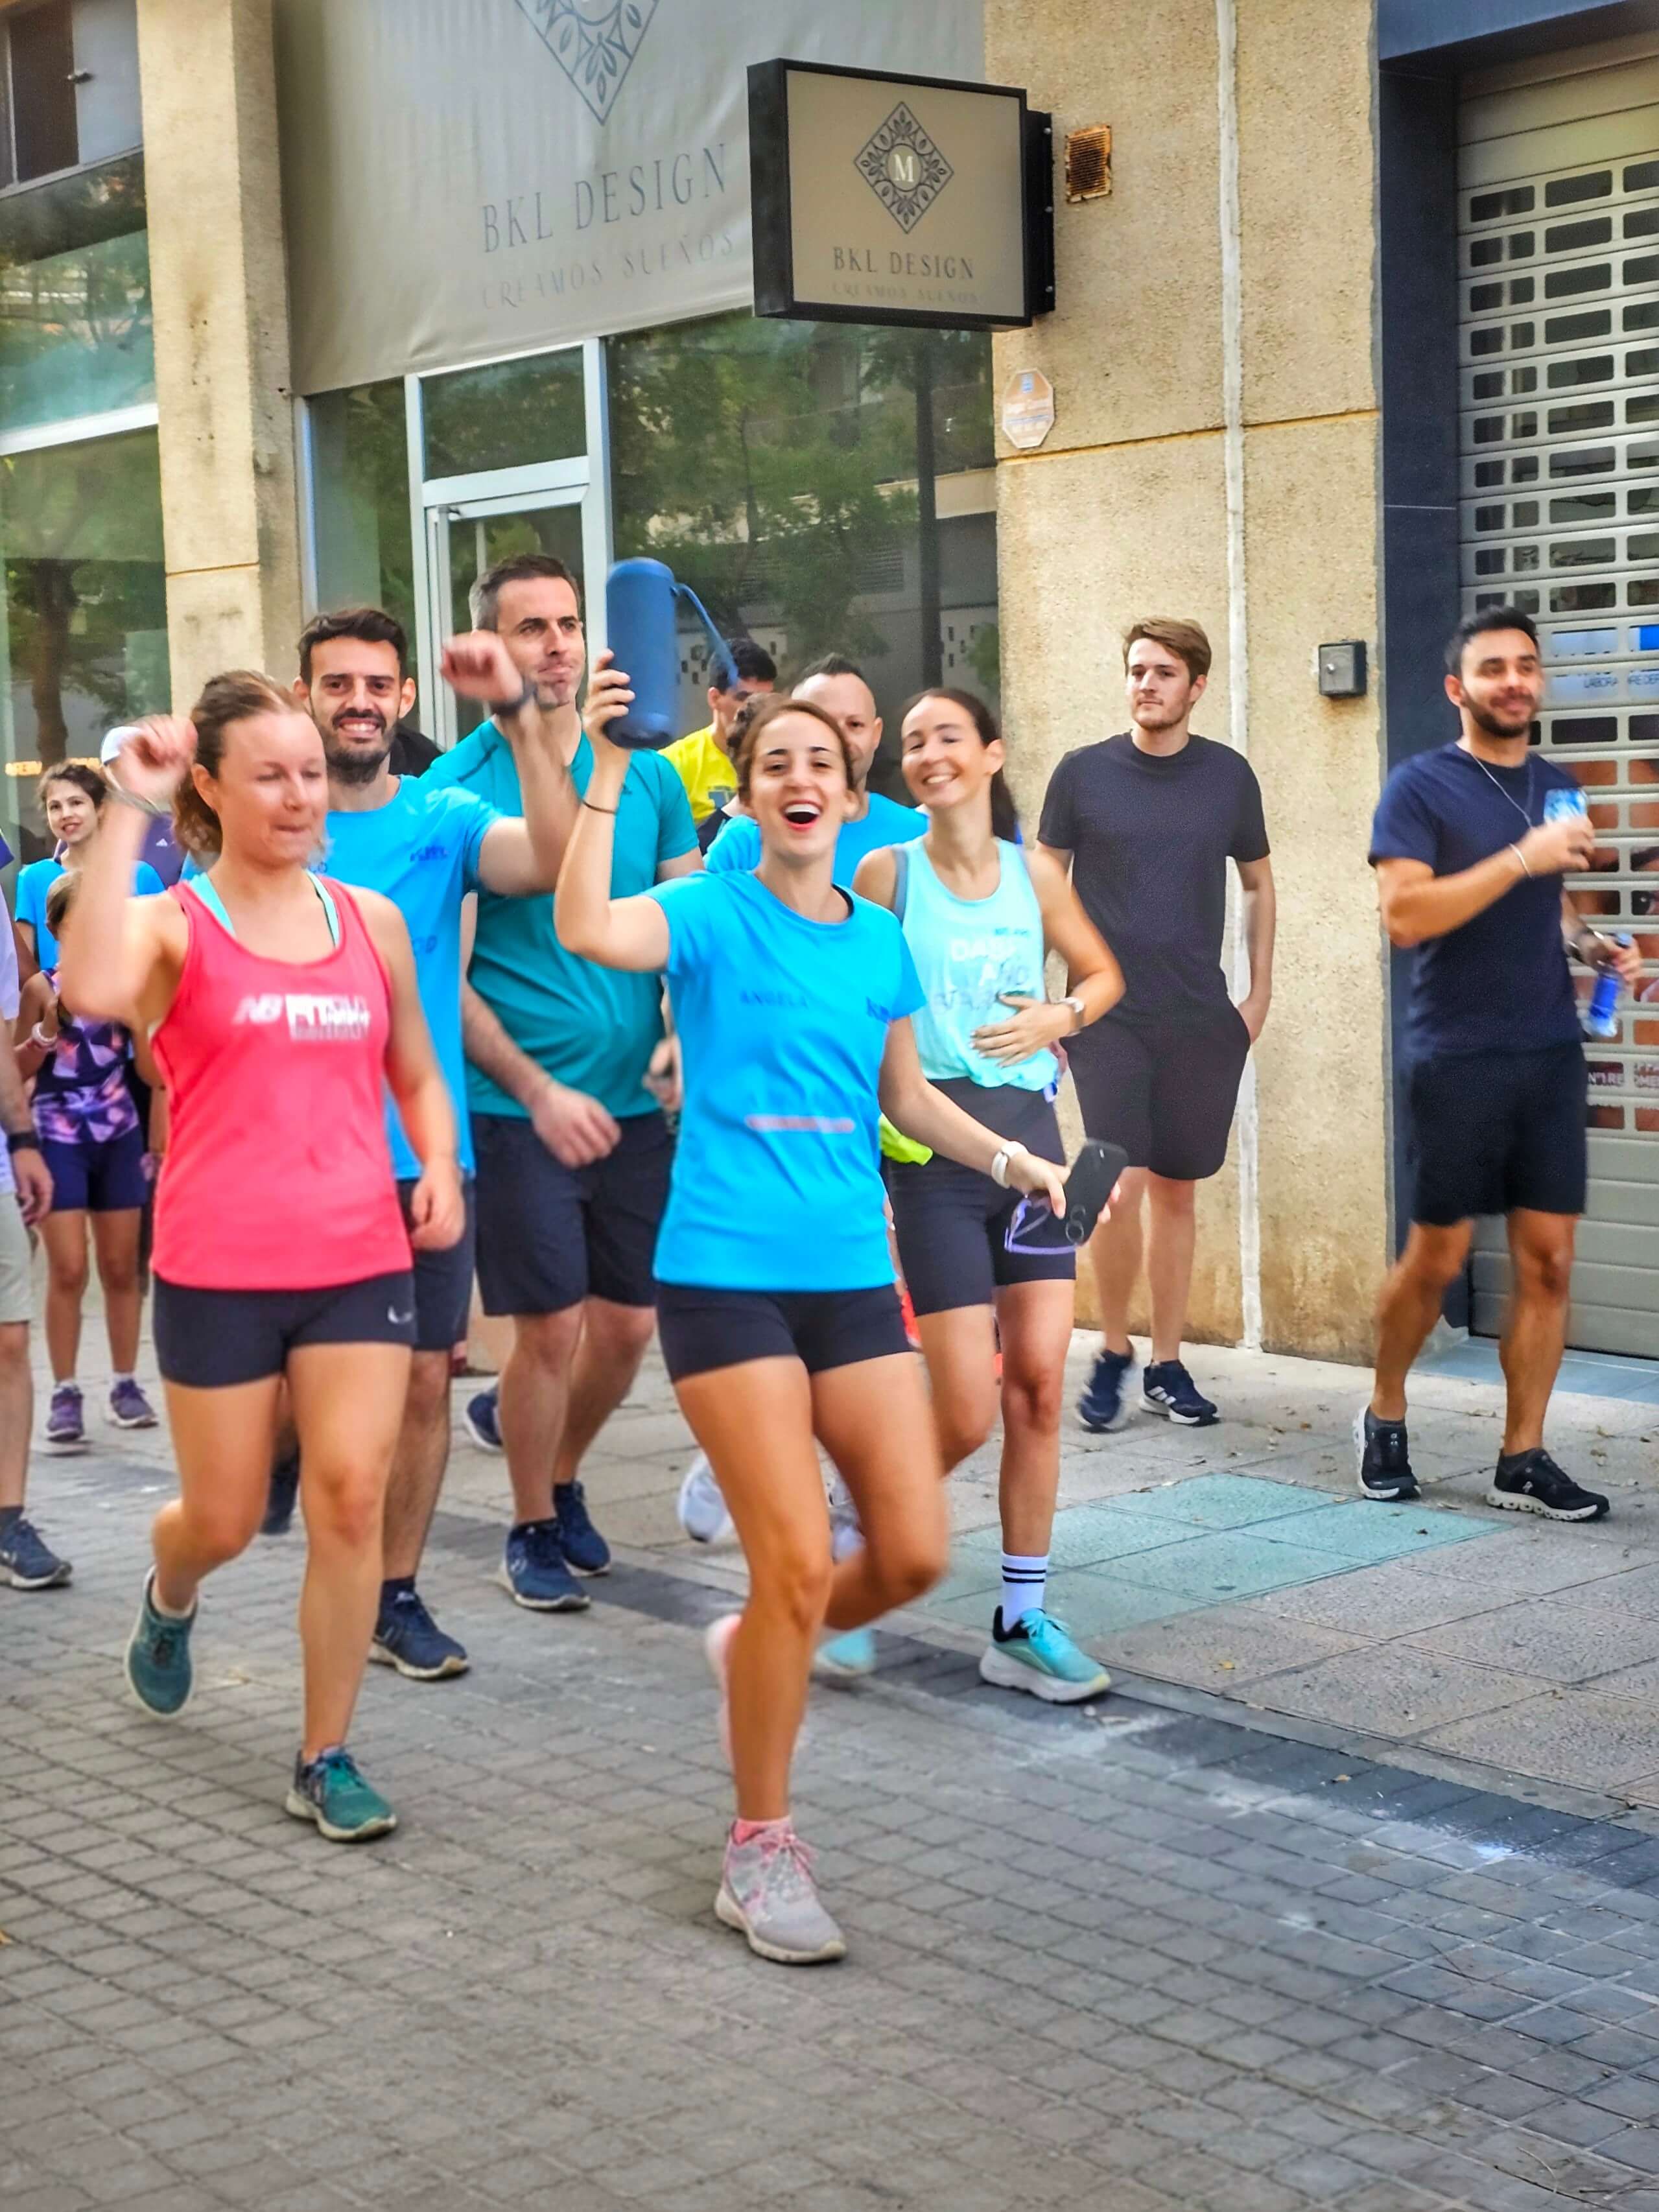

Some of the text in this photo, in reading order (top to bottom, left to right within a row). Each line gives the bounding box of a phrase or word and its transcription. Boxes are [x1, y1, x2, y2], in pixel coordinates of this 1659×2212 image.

[893, 153, 914, 183] M
[482, 143, 727, 253] BKL DESIGN
[832, 246, 974, 279] BKL DESIGN
